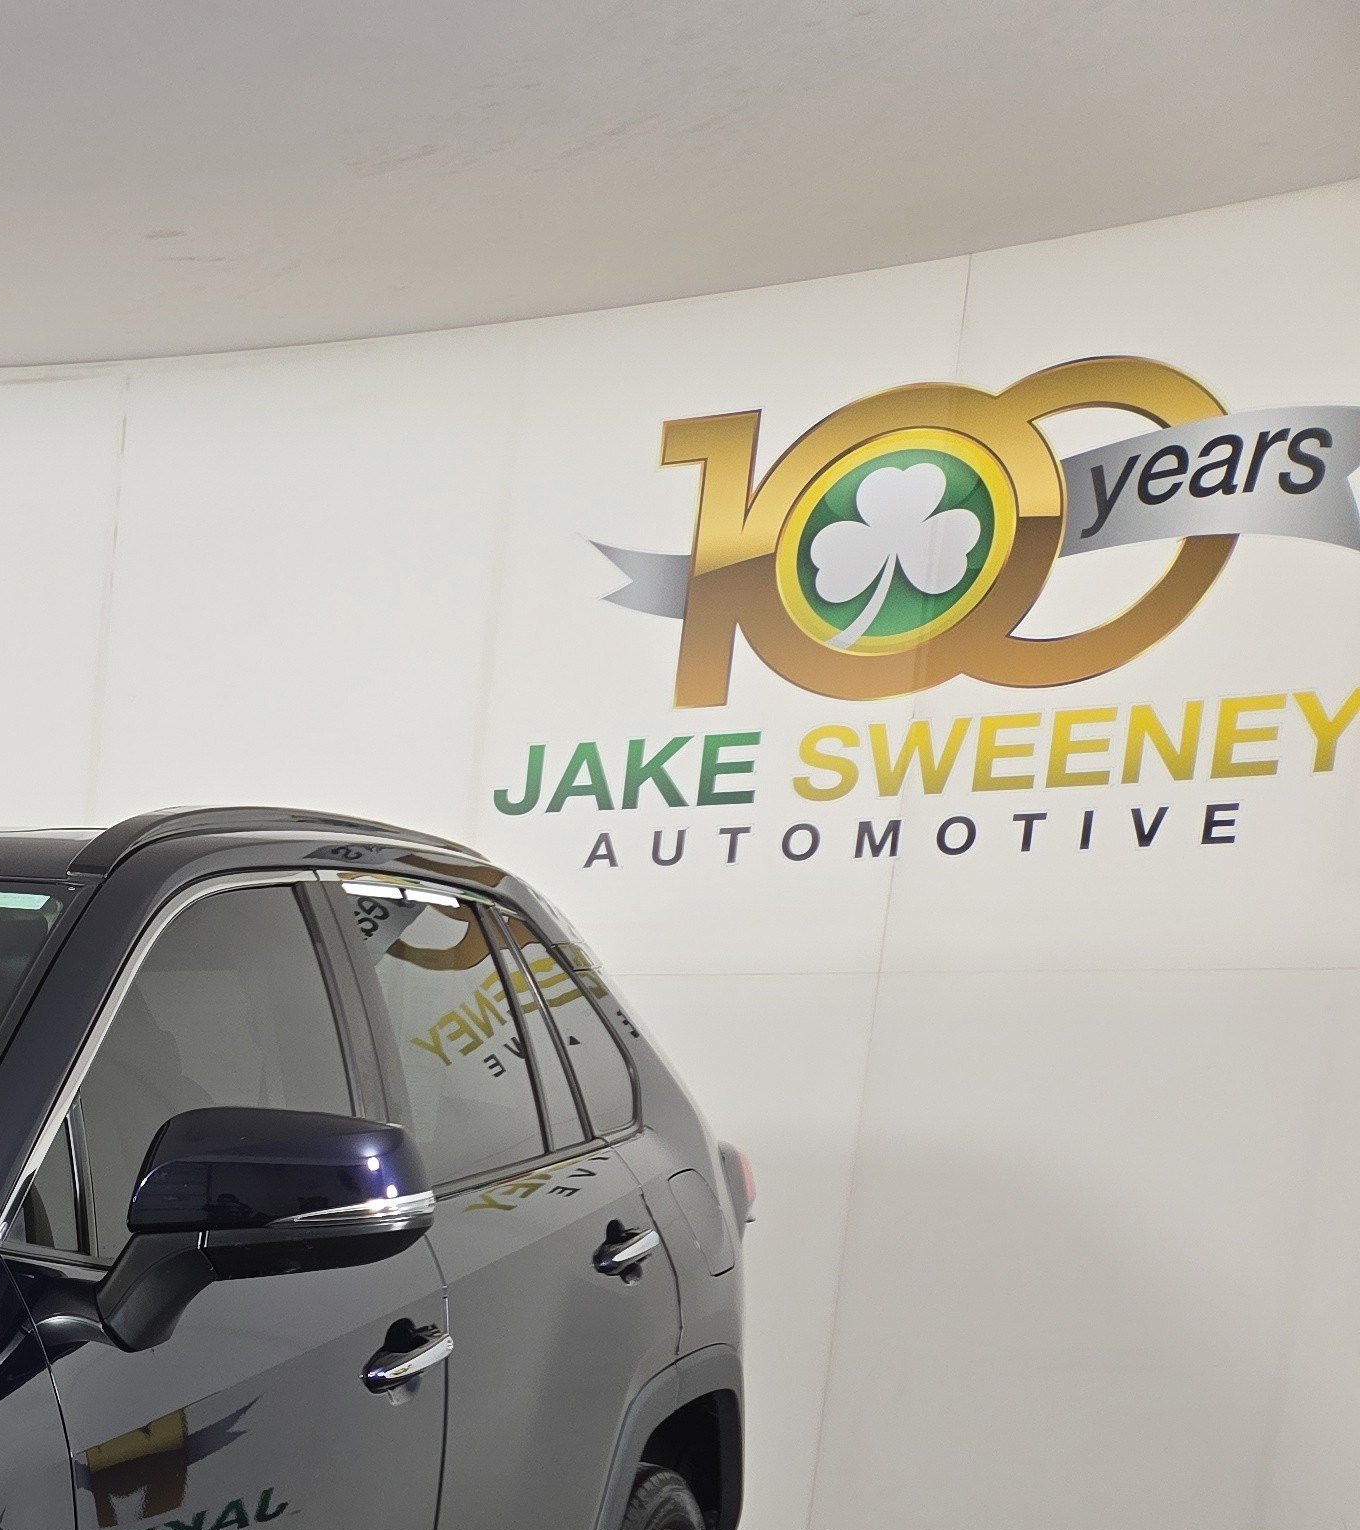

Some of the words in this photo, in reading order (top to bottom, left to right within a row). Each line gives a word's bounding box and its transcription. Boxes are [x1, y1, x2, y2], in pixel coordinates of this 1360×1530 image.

[1079, 424, 1334, 540] years
[493, 730, 763, 818] JAKE
[790, 685, 1360, 804] SWEENEY
[581, 801, 1242, 871] AUTOMOTIVE
